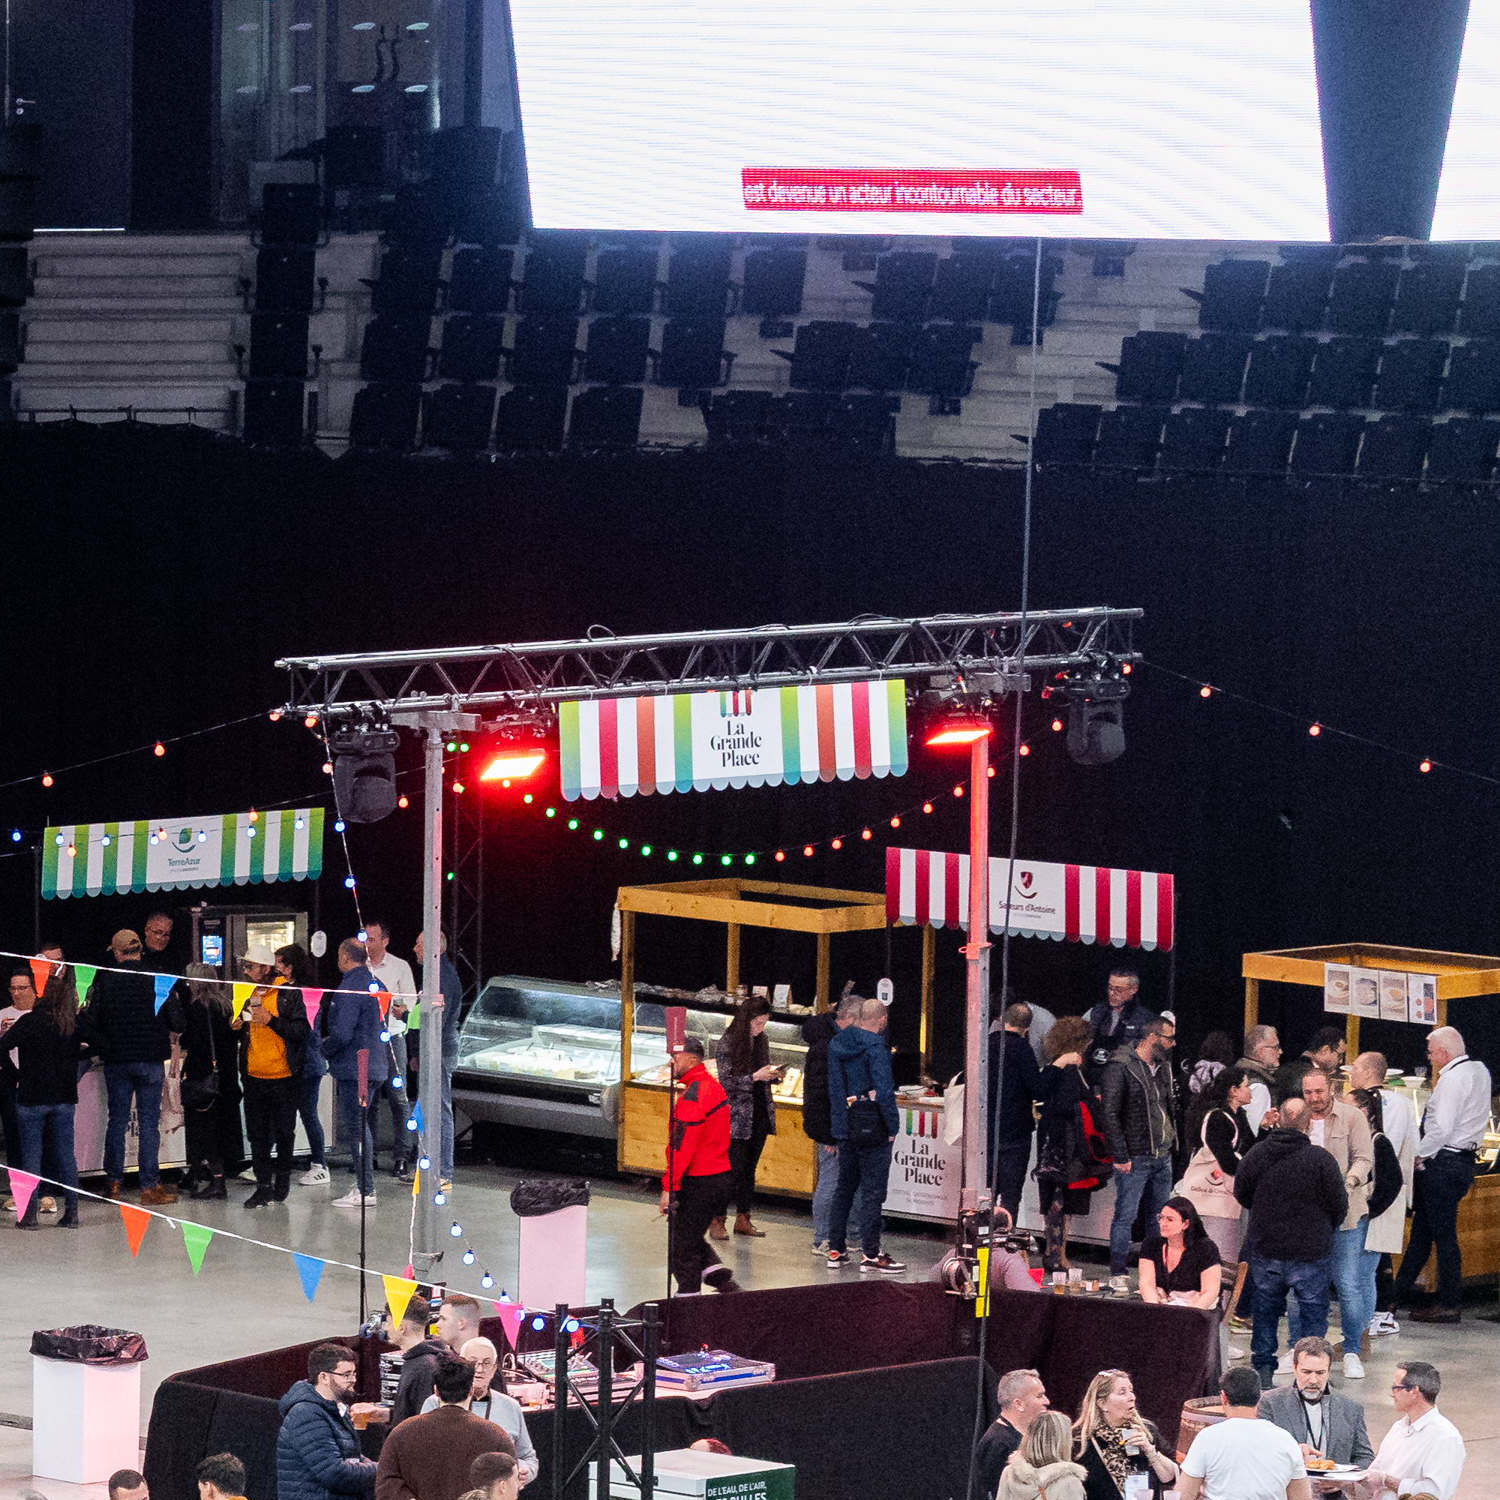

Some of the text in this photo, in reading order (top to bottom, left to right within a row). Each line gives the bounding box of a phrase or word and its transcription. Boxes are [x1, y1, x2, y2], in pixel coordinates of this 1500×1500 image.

[744, 183, 765, 202] est
[768, 181, 827, 203] devenue
[830, 186, 847, 204] un
[850, 184, 893, 204] acteur
[895, 181, 998, 206] incontournable
[1001, 183, 1020, 206] du
[727, 720, 745, 736] La
[710, 731, 762, 751] Grande
[722, 750, 760, 767] Place
[167, 857, 201, 867] TerreAzur
[999, 900, 1056, 914] Saeurs d'Antoine
[911, 1139, 929, 1155] La
[894, 1151, 946, 1171] Grande
[905, 1168, 943, 1186] Place
[708, 1488, 717, 1497] DE
[738, 1483, 748, 1492] DE
